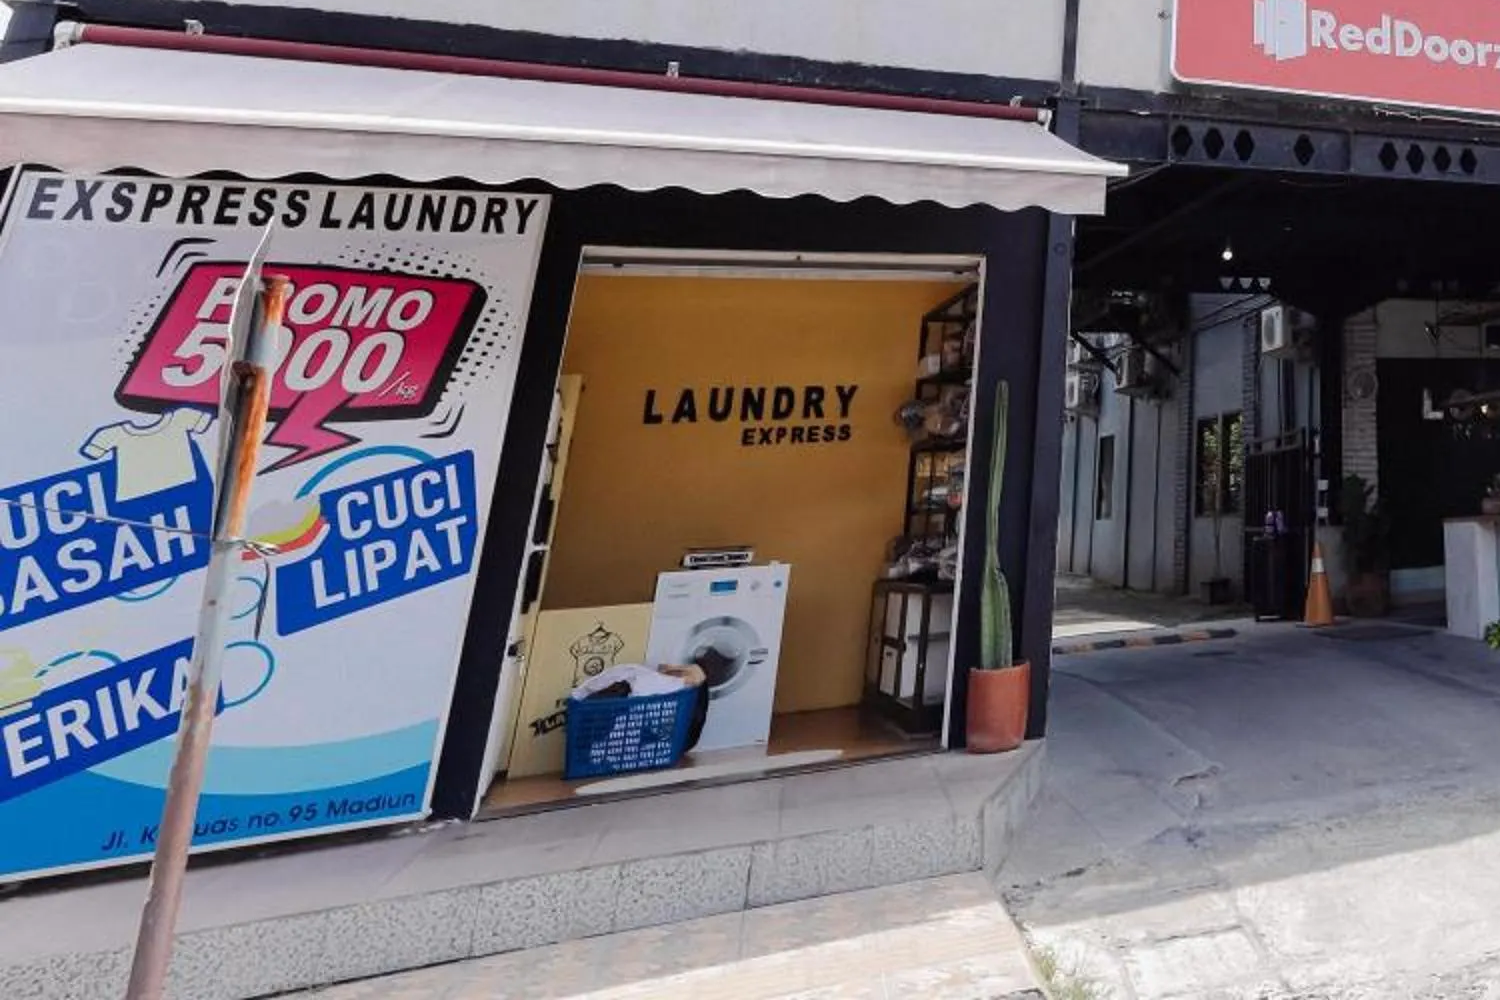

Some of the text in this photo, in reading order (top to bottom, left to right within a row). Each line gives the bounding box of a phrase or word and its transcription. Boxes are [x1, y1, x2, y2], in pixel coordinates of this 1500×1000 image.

[27, 178, 538, 235] EXSPRESS LAUNDRY
[195, 275, 433, 330] POMO
[643, 384, 858, 425] LAUNDRY
[741, 424, 852, 447] EXPRESS
[336, 465, 461, 540] CUCI
[0, 505, 195, 617] ASAH
[309, 517, 469, 610] LIPAT
[140, 816, 238, 843] Kuas
[289, 801, 318, 824] 95
[326, 791, 416, 818] Madiun
